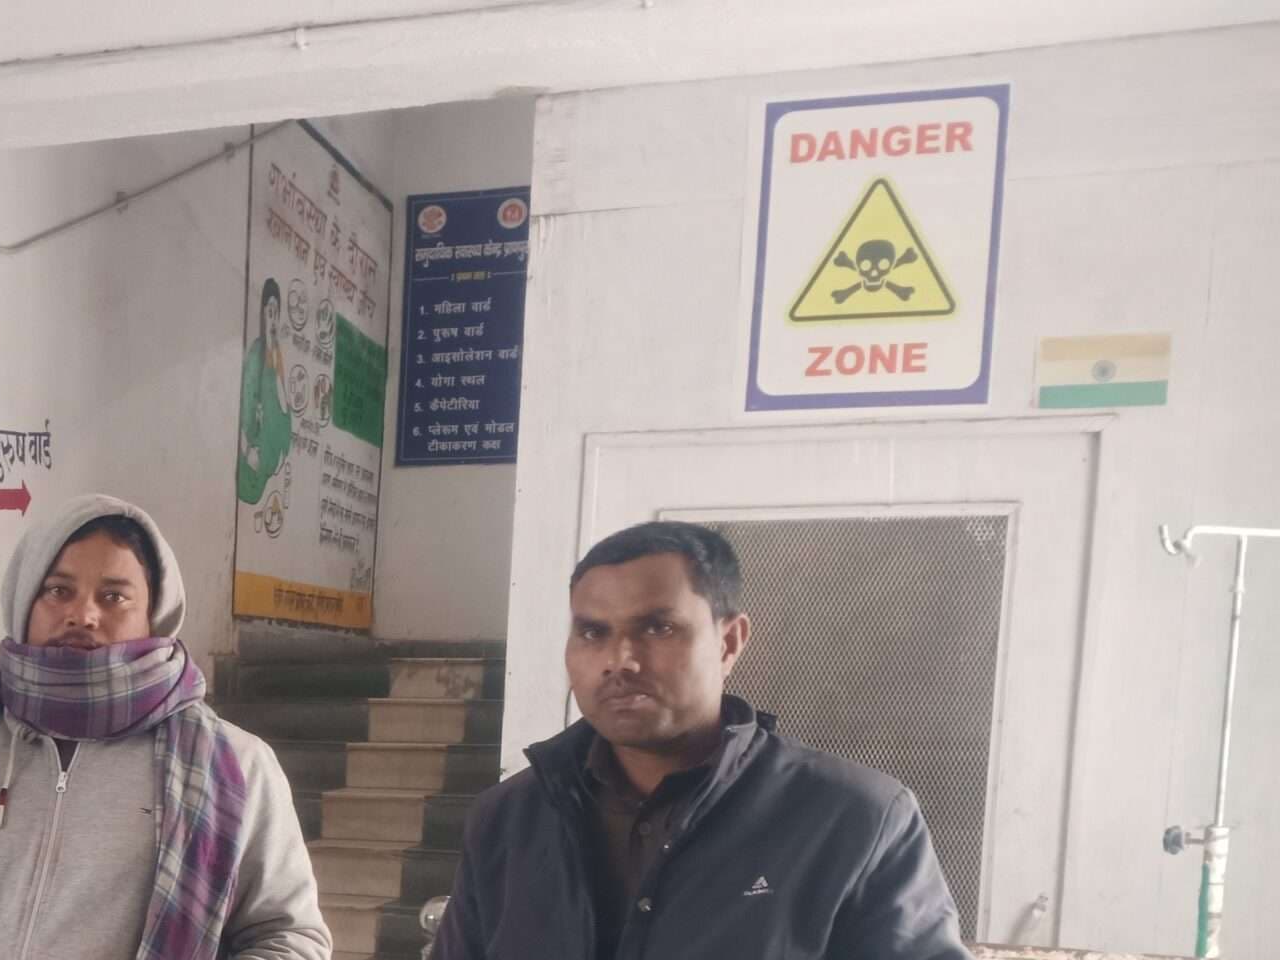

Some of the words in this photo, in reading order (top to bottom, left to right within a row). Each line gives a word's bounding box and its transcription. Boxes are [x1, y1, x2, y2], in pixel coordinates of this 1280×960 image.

[789, 121, 974, 164] DANGER
[434, 300, 466, 315] महिला
[471, 296, 492, 313] वार्ड
[464, 322, 485, 337] वार्ड
[497, 344, 519, 360] वार्ड
[804, 342, 928, 378] ZONE
